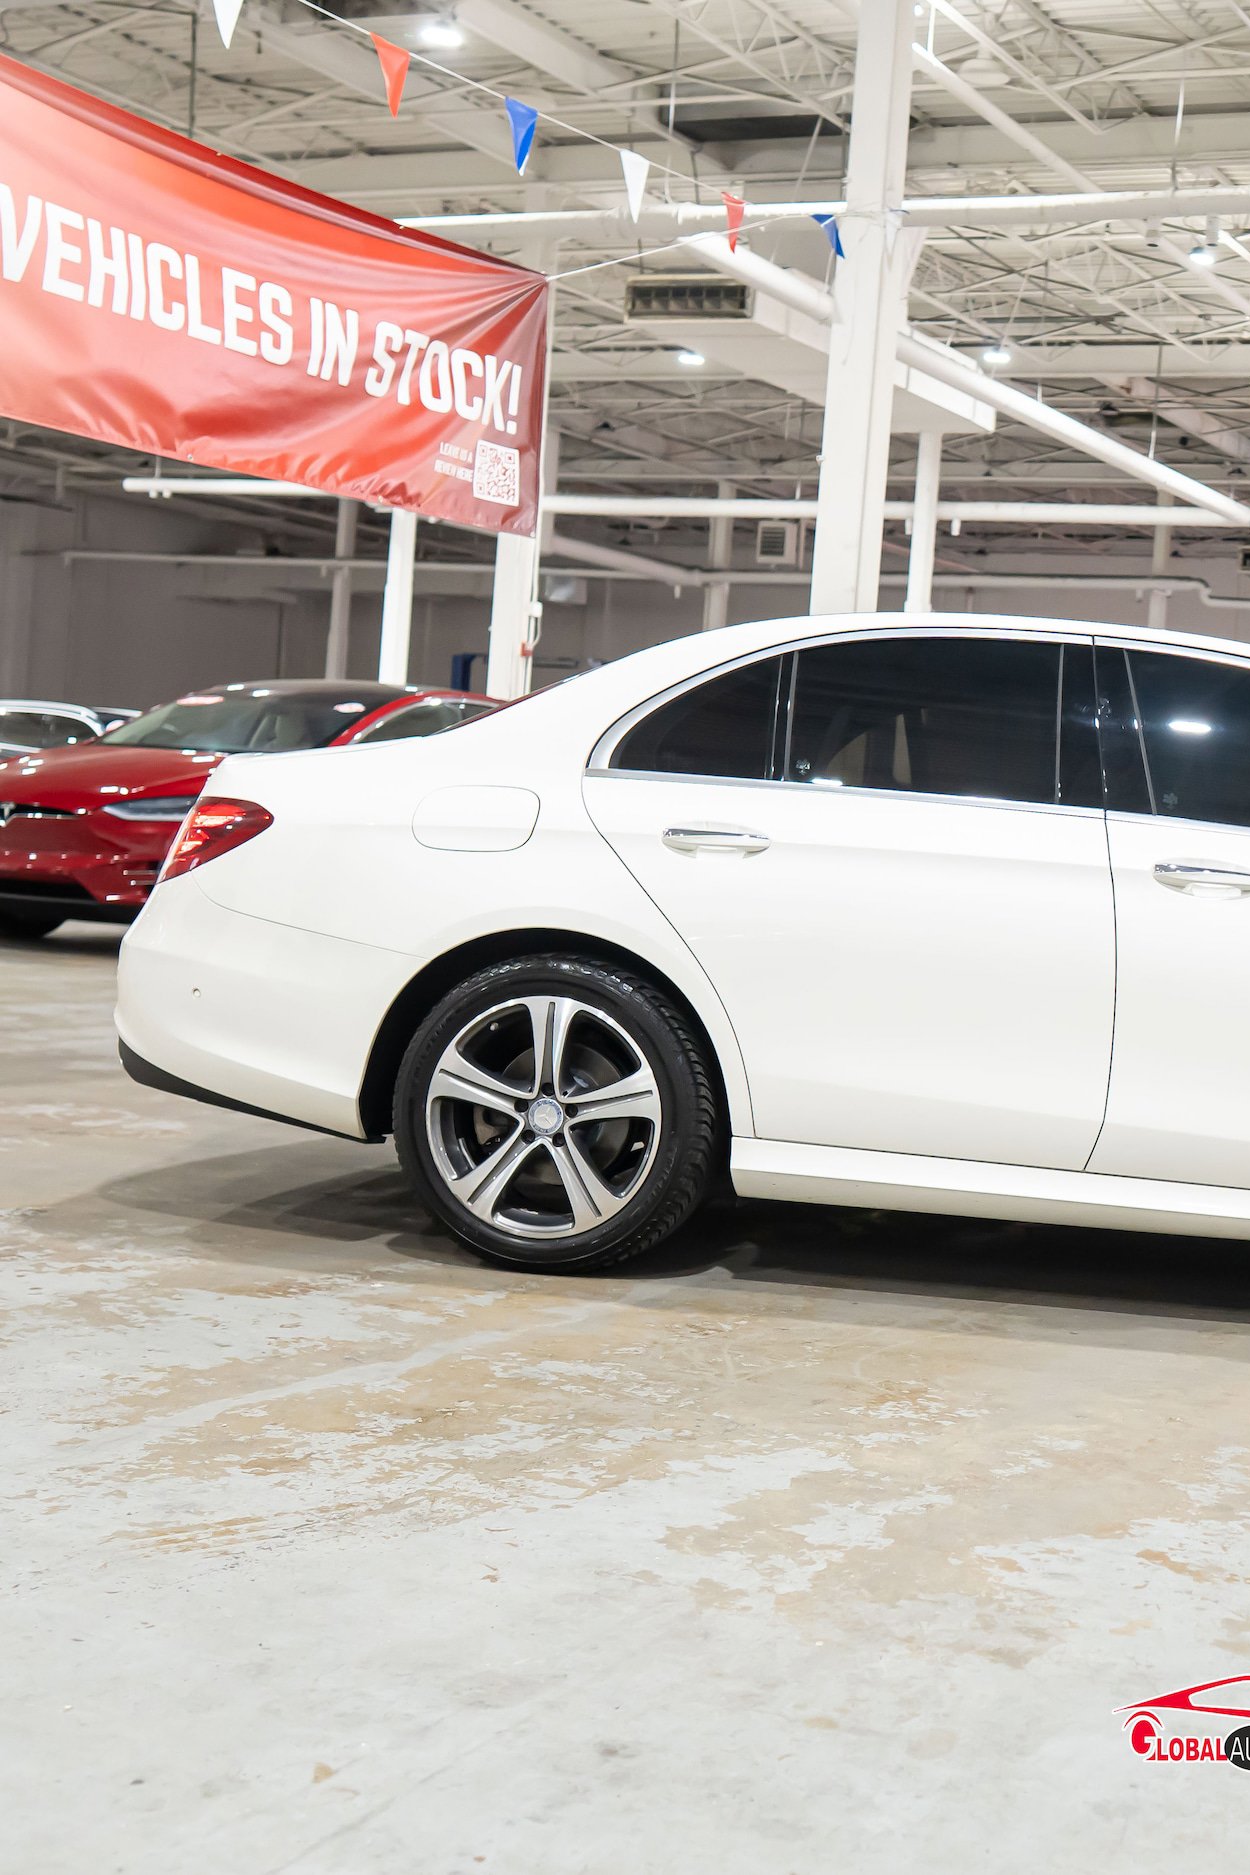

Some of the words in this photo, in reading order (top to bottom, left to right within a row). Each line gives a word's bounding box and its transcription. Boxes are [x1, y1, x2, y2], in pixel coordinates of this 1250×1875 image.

[0, 182, 293, 366] VEHICLES
[307, 297, 359, 387] IN
[366, 322, 523, 435] STOCK!
